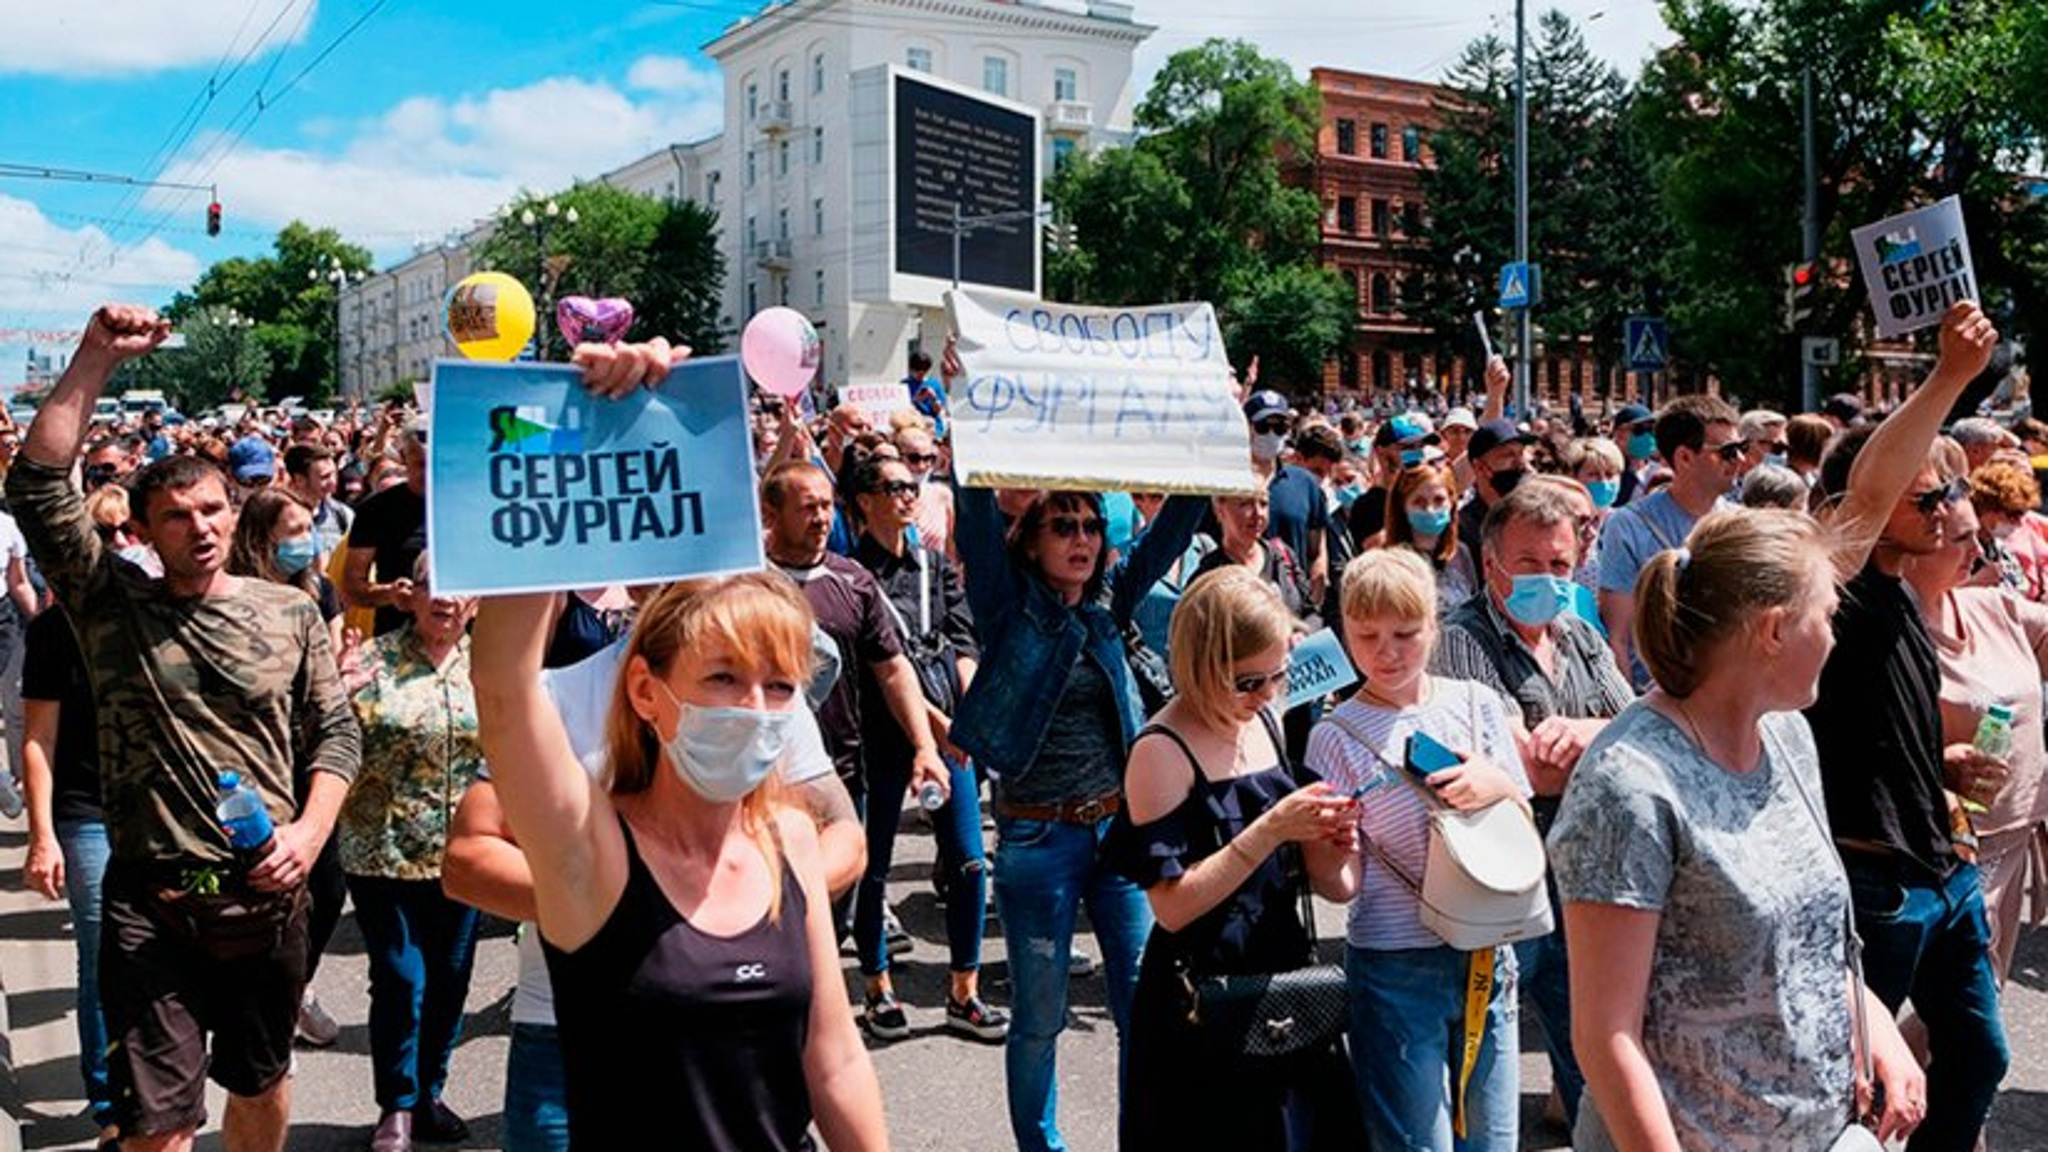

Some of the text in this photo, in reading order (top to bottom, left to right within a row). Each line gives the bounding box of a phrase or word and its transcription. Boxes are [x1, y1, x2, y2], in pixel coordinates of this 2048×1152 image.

[1881, 237, 1965, 292] СЕРГЕЙ
[1004, 309, 1213, 361] СВОБОДУ
[489, 440, 682, 501] СЕРГЕЙ
[491, 491, 705, 548] ФУРГАЛ
